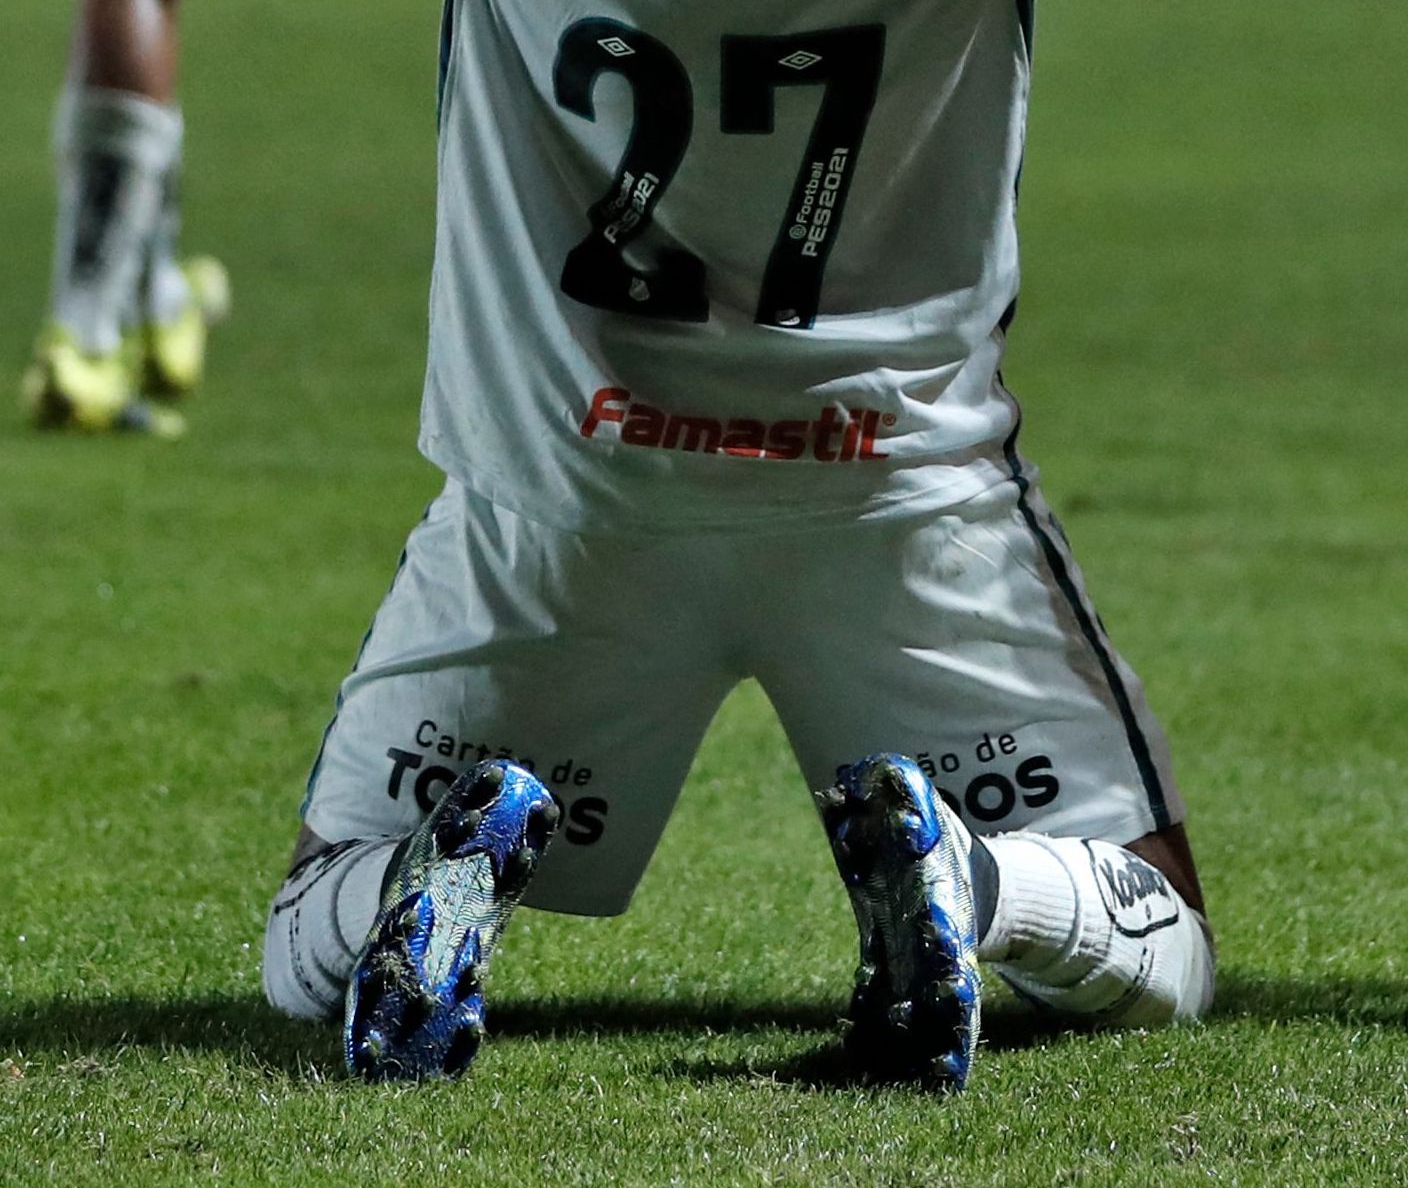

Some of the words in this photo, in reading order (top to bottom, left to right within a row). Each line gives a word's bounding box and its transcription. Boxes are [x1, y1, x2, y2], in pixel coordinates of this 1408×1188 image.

[552, 16, 887, 330] 27
[801, 147, 849, 257] PES2021
[387, 746, 608, 845] TOS
[551, 759, 592, 786] de
[975, 732, 1018, 763] de
